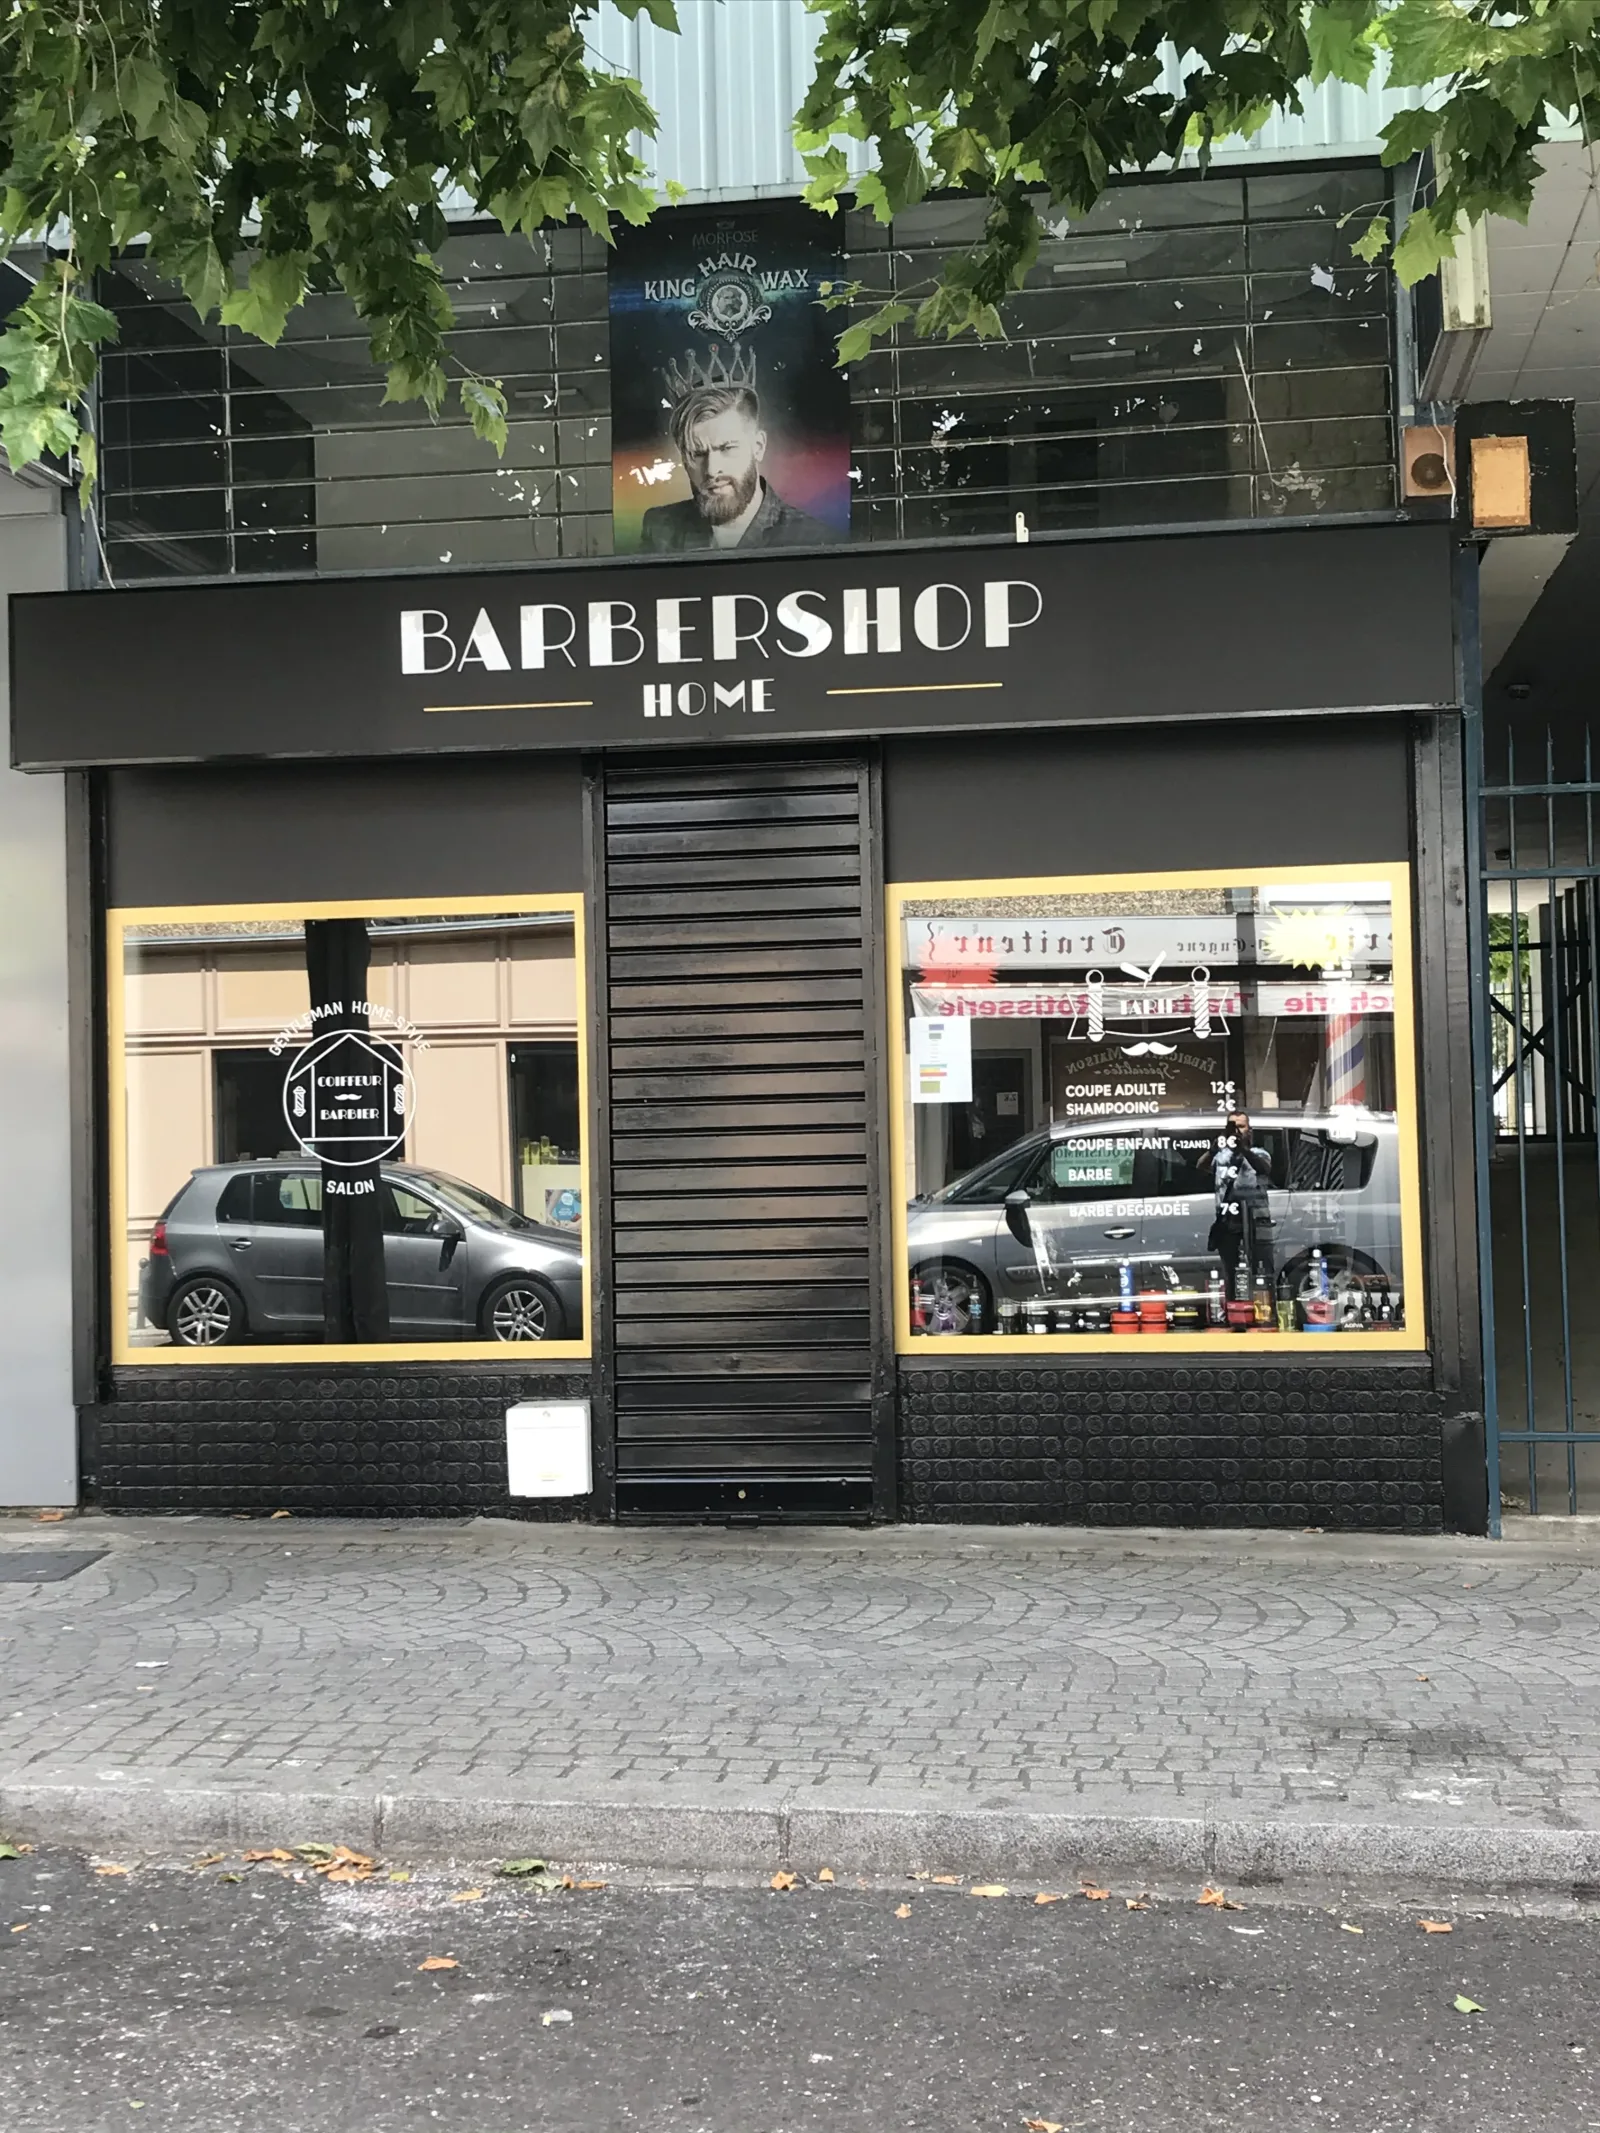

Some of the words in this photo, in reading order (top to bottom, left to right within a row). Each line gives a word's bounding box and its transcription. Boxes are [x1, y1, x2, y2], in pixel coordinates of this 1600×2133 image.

[644, 277, 696, 302] KING
[697, 252, 757, 278] HAIR
[759, 268, 810, 292] WAX
[400, 581, 1043, 675] BARBERSHOP
[642, 678, 776, 718] HOME
[1120, 998, 1175, 1015] TARIF
[269, 1001, 344, 1056] GENTLEMAN
[317, 1075, 382, 1087] COIFFEUR
[1065, 1084, 1112, 1098] COUPE
[1114, 1082, 1167, 1096] ADULTE
[1210, 1081, 1236, 1094] 12€
[320, 1108, 380, 1121] BARBIER
[1066, 1101, 1160, 1116] SHAMPOOING
[1216, 1099, 1236, 1112] 2€
[1067, 1138, 1114, 1151] COUPE
[1116, 1137, 1171, 1150] ENFANT
[1217, 1136, 1238, 1149] 8€
[1068, 1168, 1113, 1181] BARBE
[1219, 1166, 1238, 1179] 7€
[326, 1178, 376, 1195] SALON
[1069, 1204, 1116, 1217] BARBE
[1220, 1202, 1240, 1216] 7€
